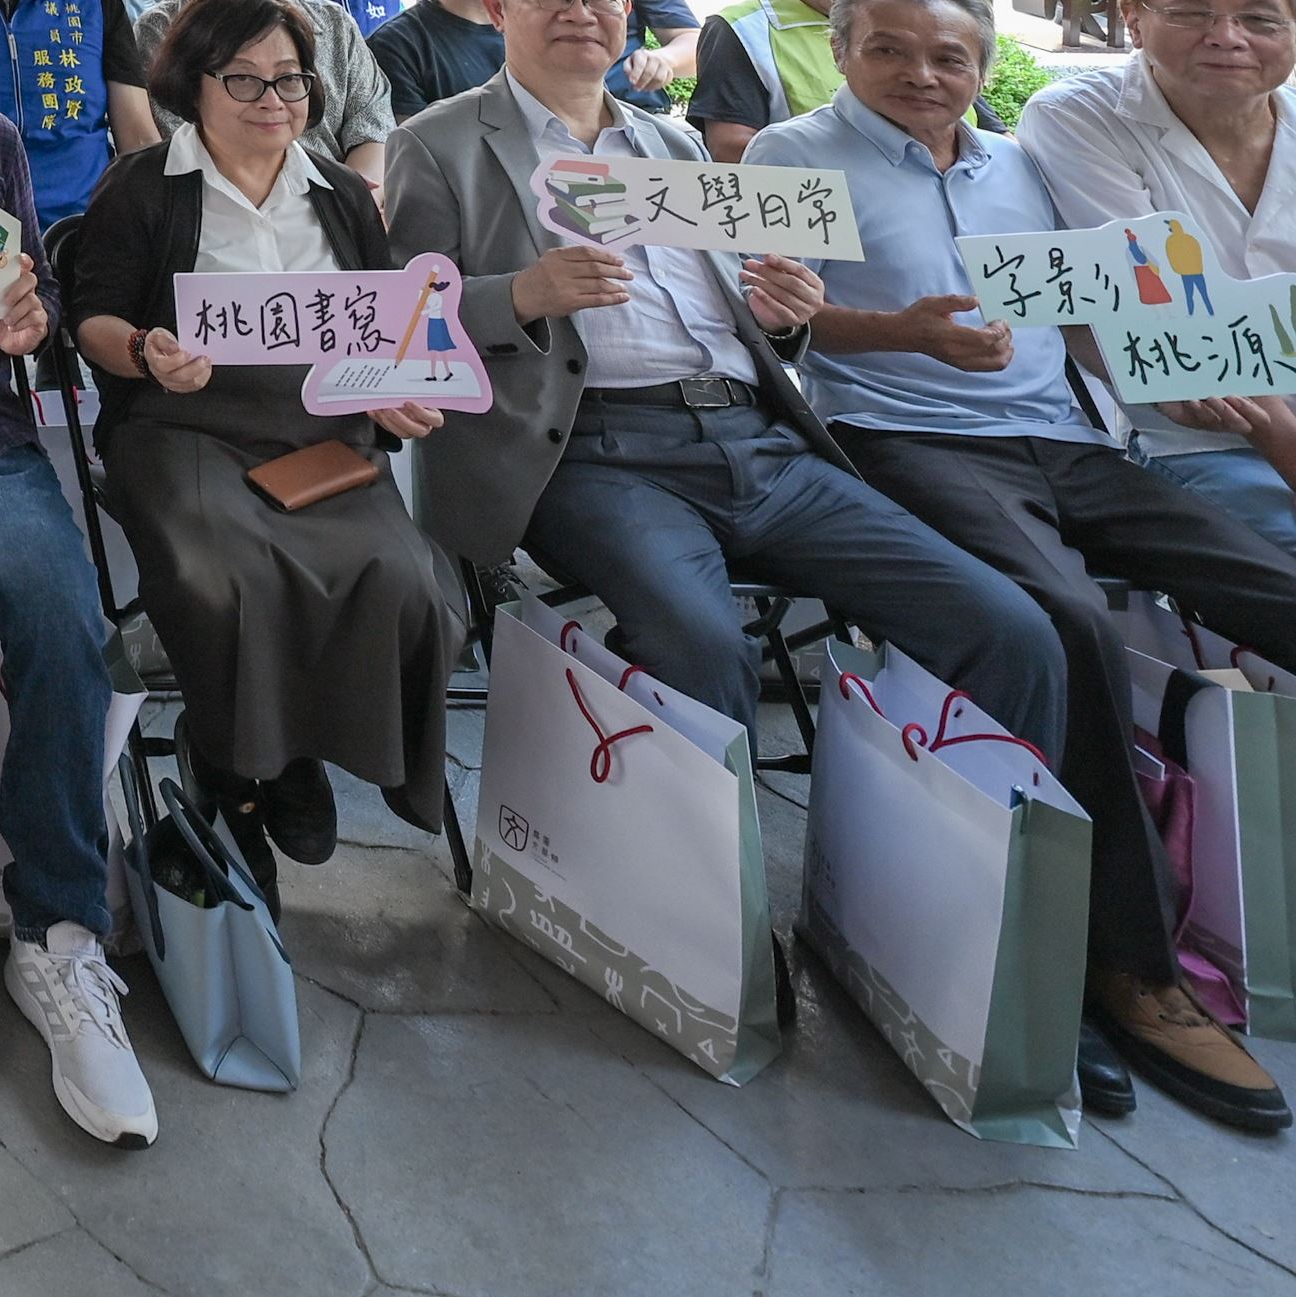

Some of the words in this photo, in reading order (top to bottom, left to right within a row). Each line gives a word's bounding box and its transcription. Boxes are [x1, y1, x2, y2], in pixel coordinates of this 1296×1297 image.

[59, 48, 86, 121] 林政賢
[645, 172, 839, 245] 文學日常
[193, 284, 397, 356] 桃園書寫
[1122, 314, 1296, 386] 桃源
